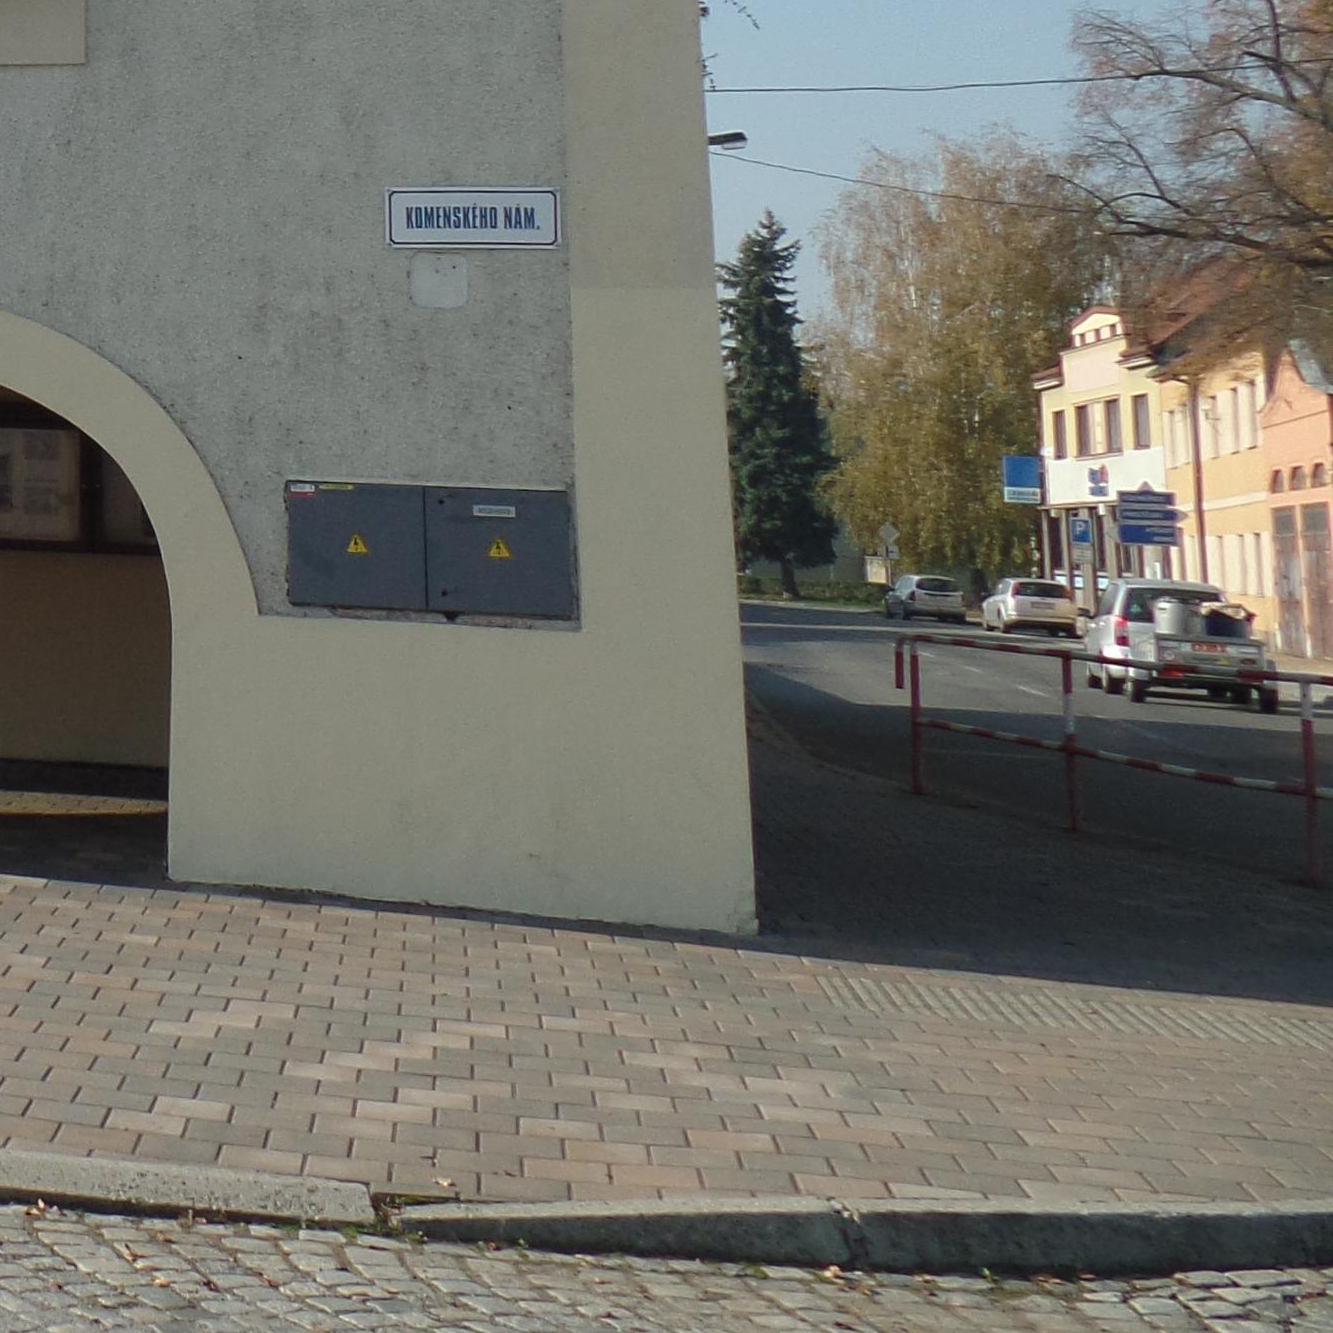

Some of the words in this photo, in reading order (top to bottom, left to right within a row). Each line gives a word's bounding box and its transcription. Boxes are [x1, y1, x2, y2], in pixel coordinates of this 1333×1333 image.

[405, 203, 498, 230] KOMENSKÉHO
[503, 203, 541, 231] NÁM.
[1076, 521, 1085, 536] P
